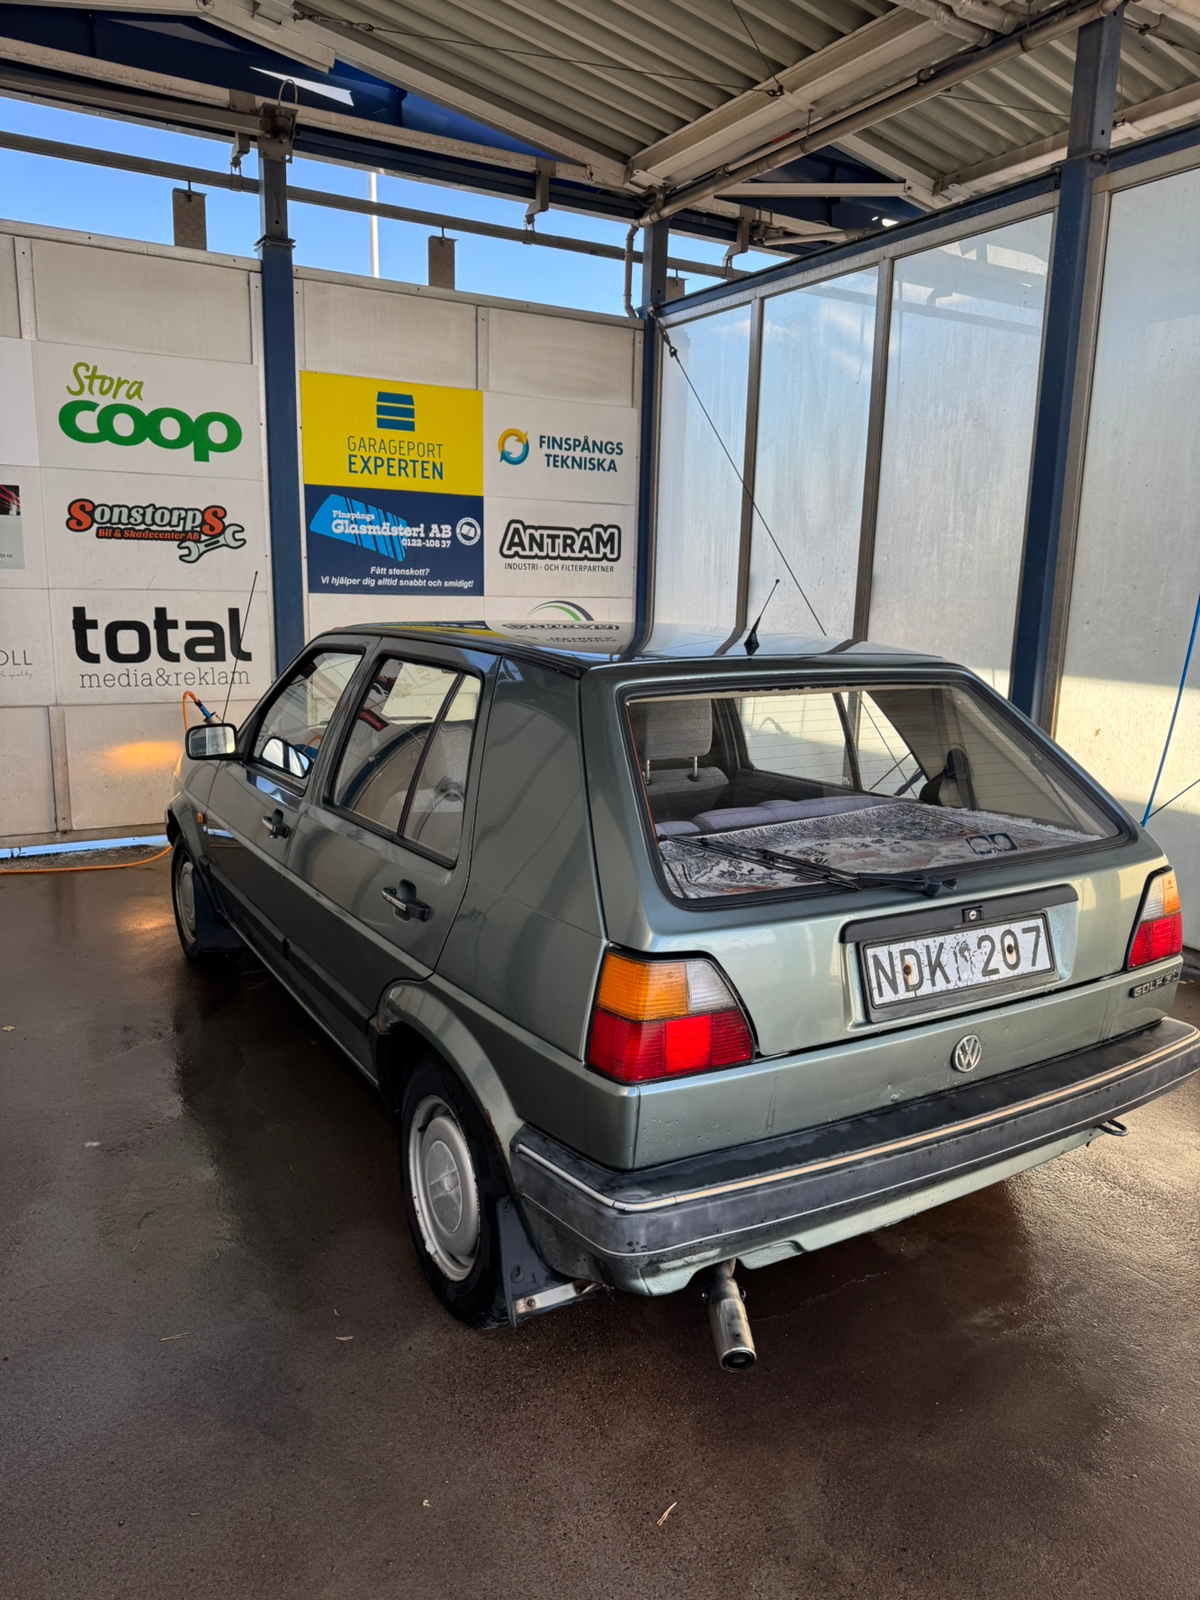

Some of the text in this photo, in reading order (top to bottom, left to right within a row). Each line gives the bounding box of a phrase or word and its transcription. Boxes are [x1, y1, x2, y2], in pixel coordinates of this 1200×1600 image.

[66, 361, 144, 401] Stora
[58, 400, 243, 462] coop
[347, 435, 443, 459] GARAGEPORT
[539, 435, 623, 456] FINSPÅNGS
[348, 454, 443, 480] EXPERTEN
[545, 453, 617, 472] TEKNISKA
[332, 510, 375, 522] Finspångs
[98, 528, 199, 540] Bil & Skadecenter AB
[331, 518, 425, 538] Glasmästeri
[429, 524, 451, 538] AB
[503, 523, 619, 560] ANTRAM
[370, 566, 430, 576] Fått stenskott?
[504, 562, 615, 573] INDUSTRI- OCH FILTERPARTNER
[321, 576, 473, 589] Vi hjälper dig alltid snabbt och smidigt!
[72, 606, 252, 664] total
[79, 667, 250, 689] media&reklam
[872, 925, 1041, 998] NDK 207
